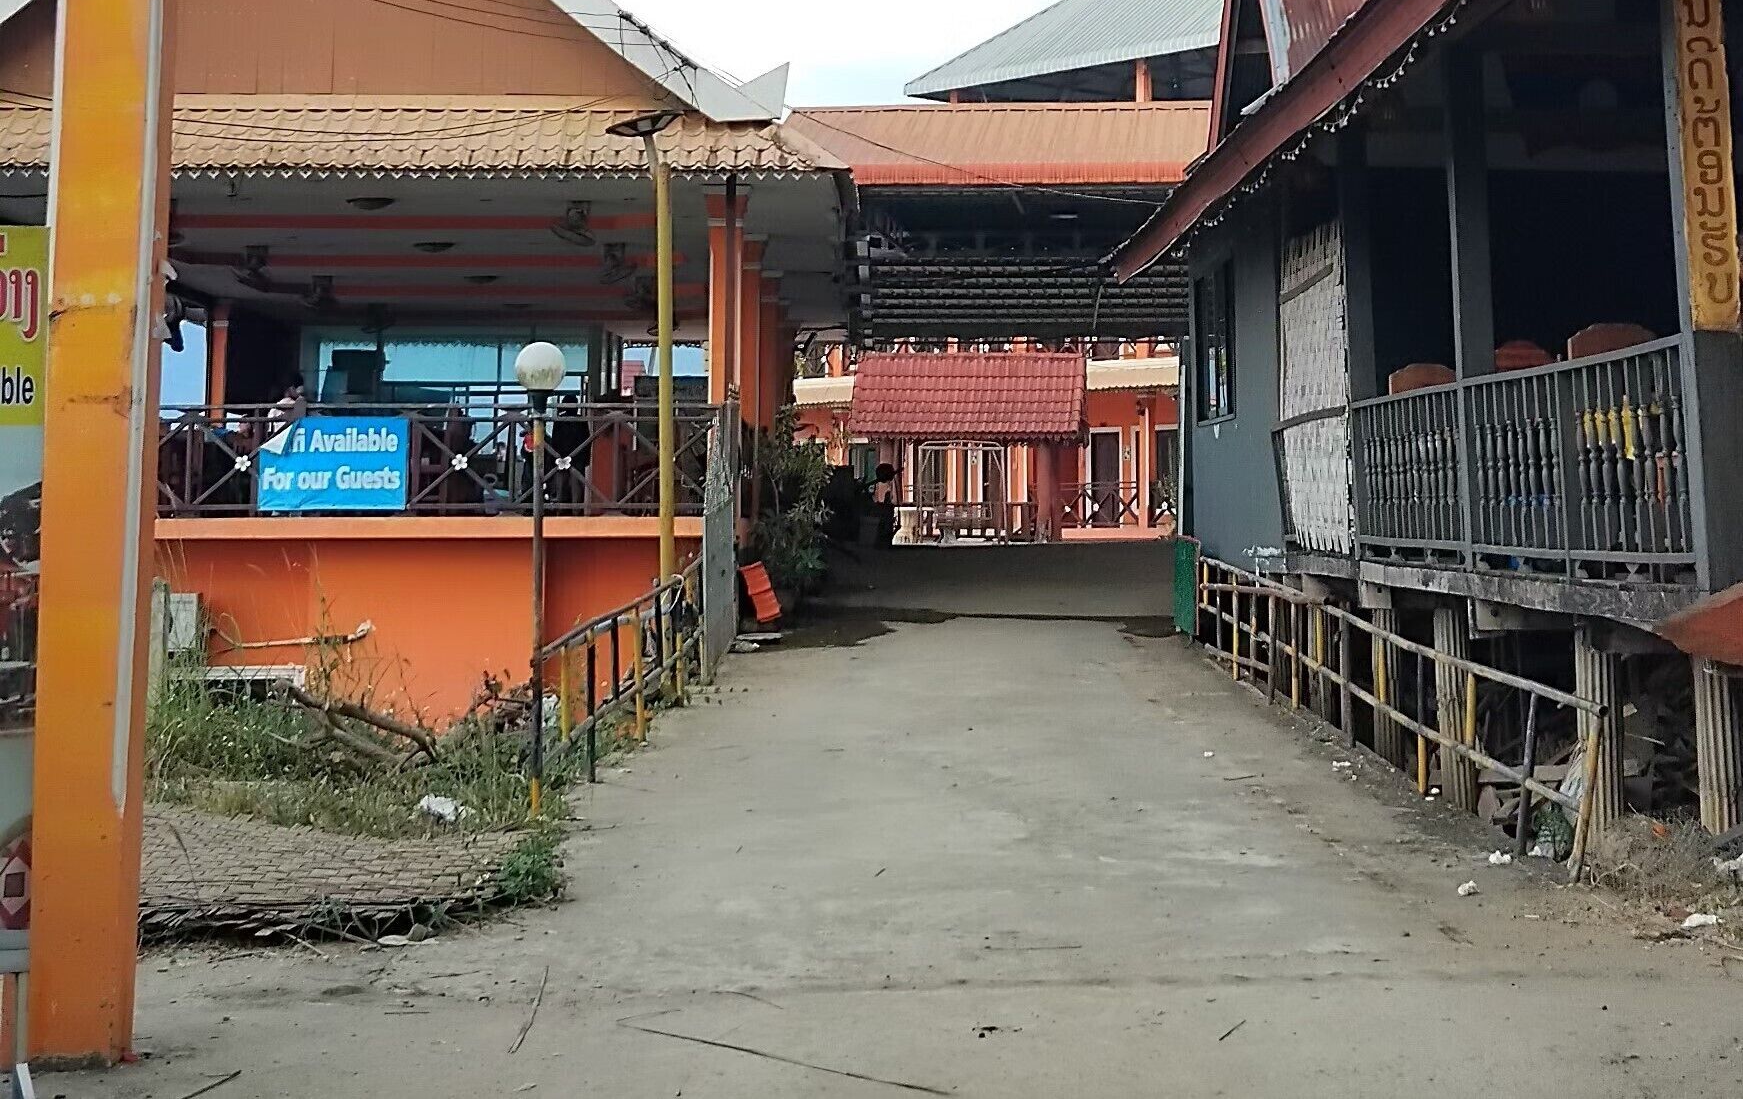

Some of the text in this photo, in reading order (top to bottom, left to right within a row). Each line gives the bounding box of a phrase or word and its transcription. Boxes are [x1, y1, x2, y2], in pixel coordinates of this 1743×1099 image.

[309, 427, 399, 452] Available
[262, 465, 401, 490] For our Guests
